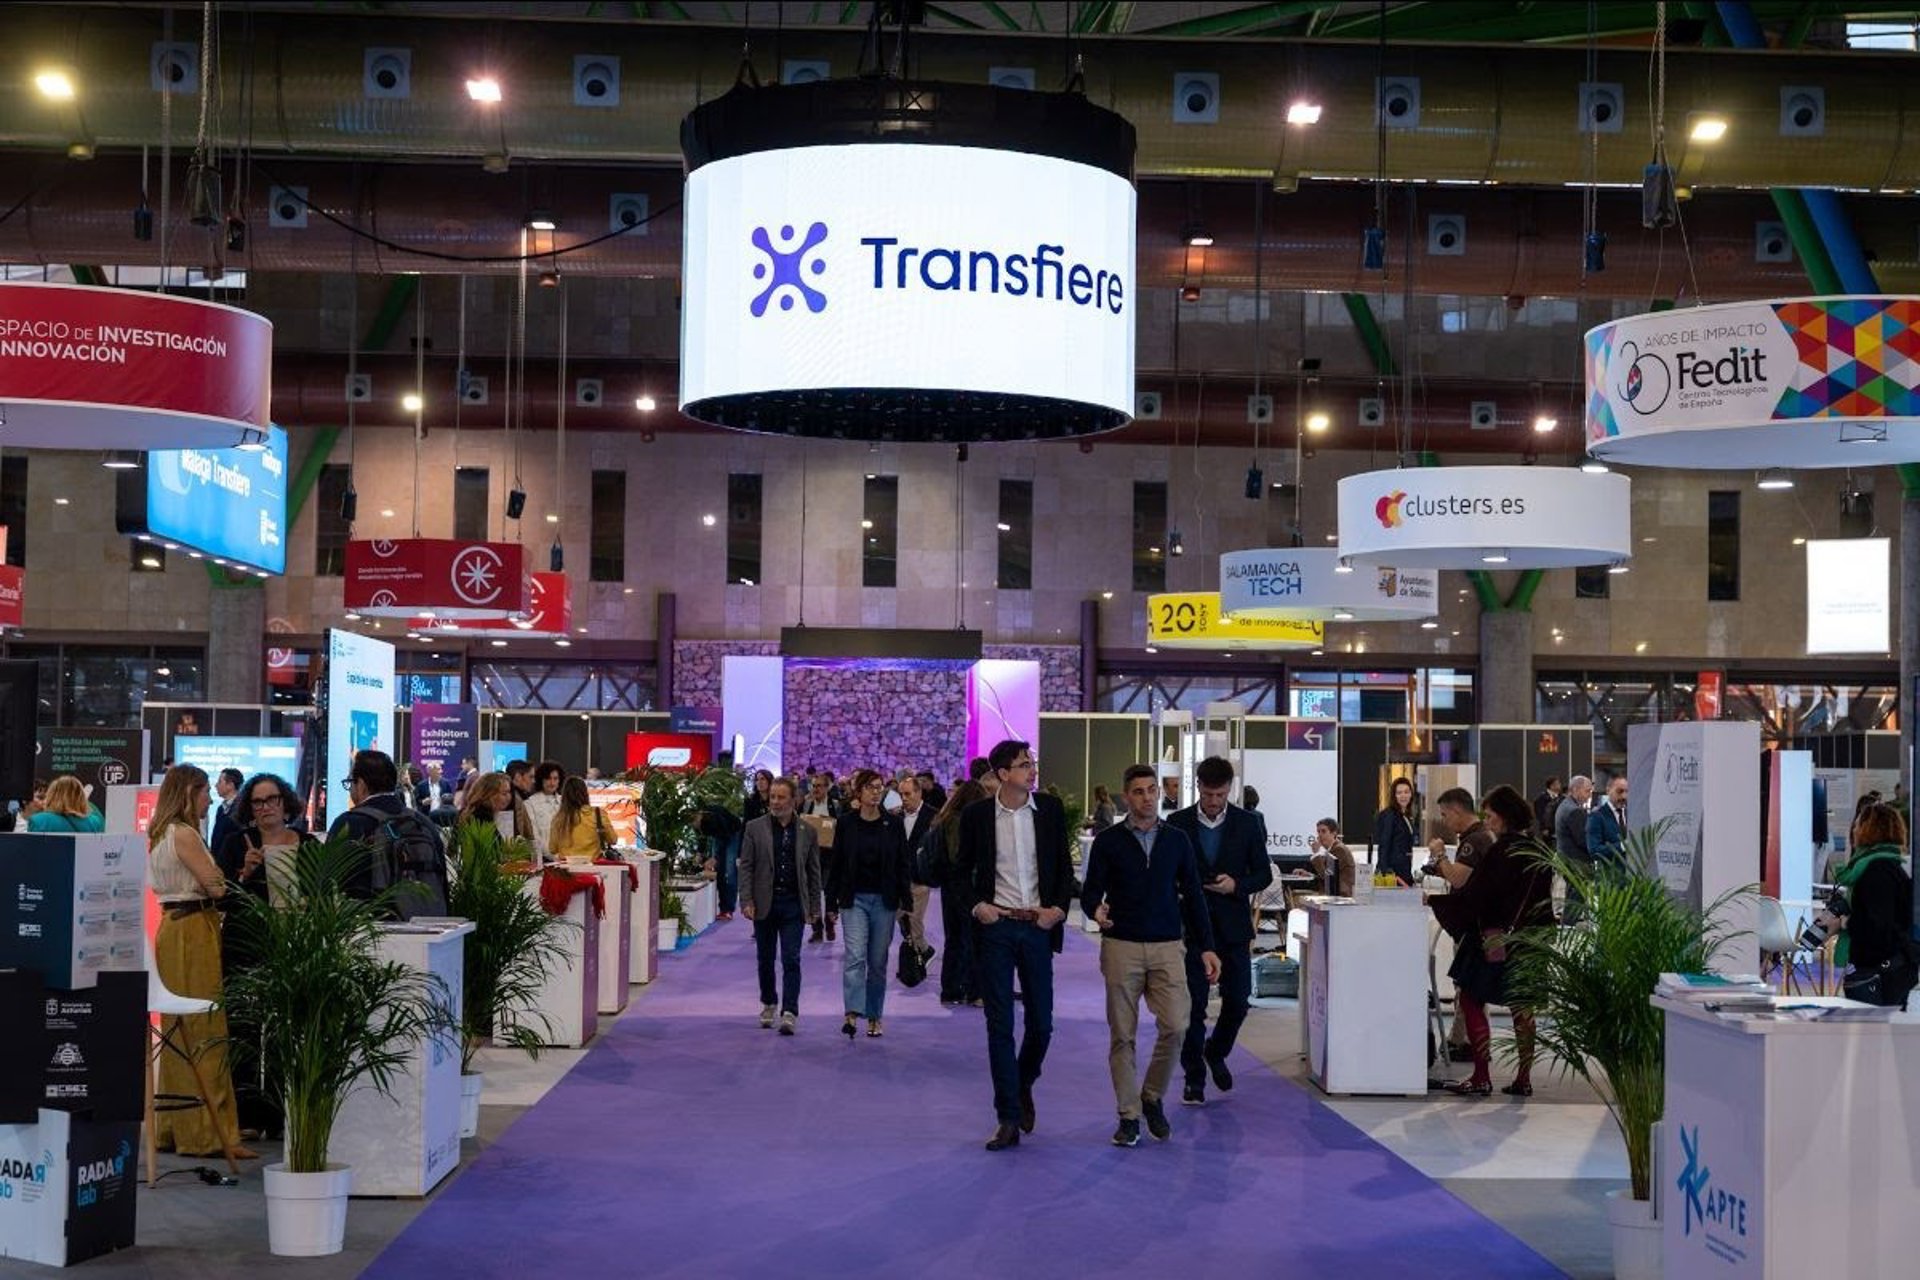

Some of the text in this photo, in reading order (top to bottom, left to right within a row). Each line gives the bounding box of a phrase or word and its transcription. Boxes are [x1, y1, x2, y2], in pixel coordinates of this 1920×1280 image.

[860, 237, 1123, 314] Transfiere
[75, 327, 94, 340] DE
[98, 325, 227, 357] INVESTIGACIÓN
[1681, 330, 1699, 343] DE
[1703, 323, 1767, 341] IMPACTO
[1676, 346, 1767, 390] Fedit
[1406, 494, 1525, 517] clusters.es
[1226, 562, 1300, 579] SALAMANCA
[1248, 577, 1302, 596] TECH
[1161, 603, 1195, 632] 20
[421, 729, 470, 738] Exhibitors
[421, 739, 456, 747] service
[421, 746, 450, 756] office.
[104, 772, 125, 784] UP
[1705, 1186, 1747, 1236] APTE
